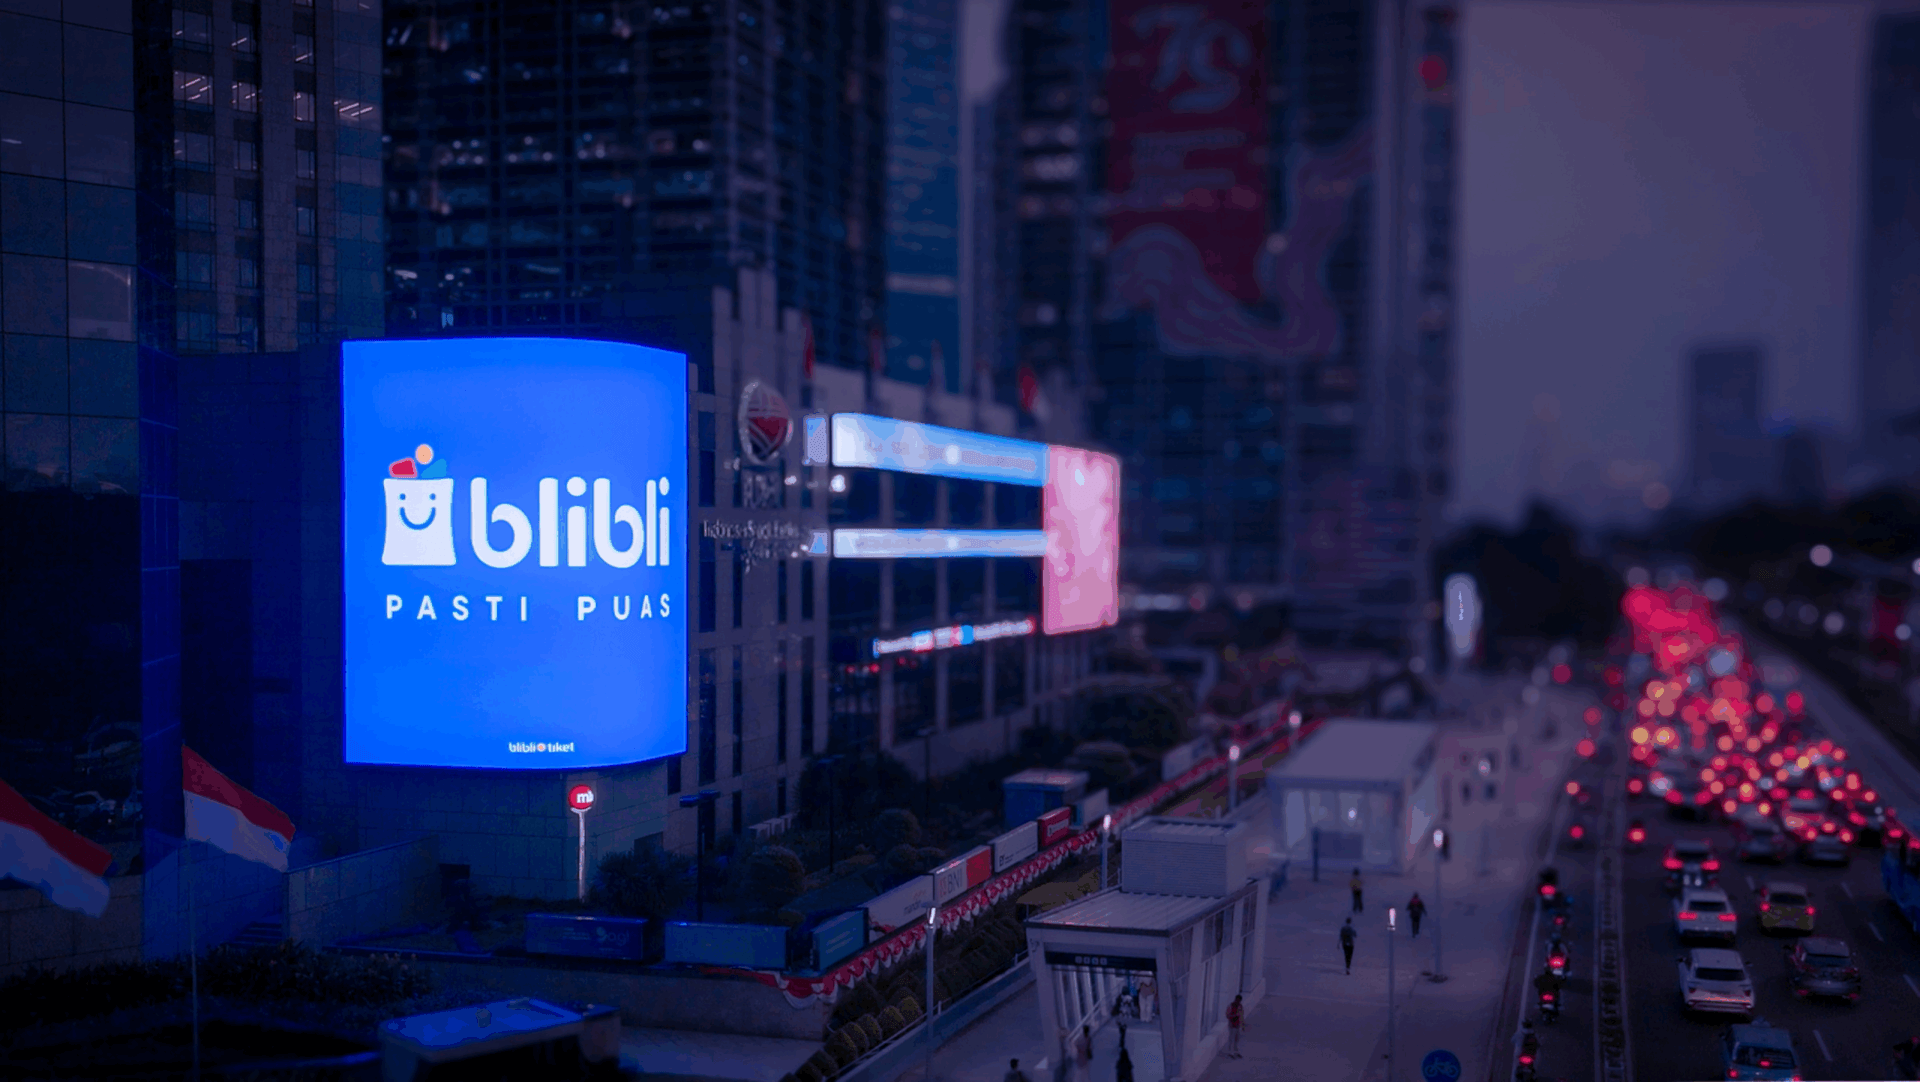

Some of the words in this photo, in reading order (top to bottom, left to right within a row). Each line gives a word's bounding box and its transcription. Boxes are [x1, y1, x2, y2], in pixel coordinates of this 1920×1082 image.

[470, 476, 670, 569] blibli
[386, 594, 528, 621] PASTI
[577, 593, 670, 621] PUAS
[508, 741, 536, 752] blibli
[947, 868, 963, 894] BNI
